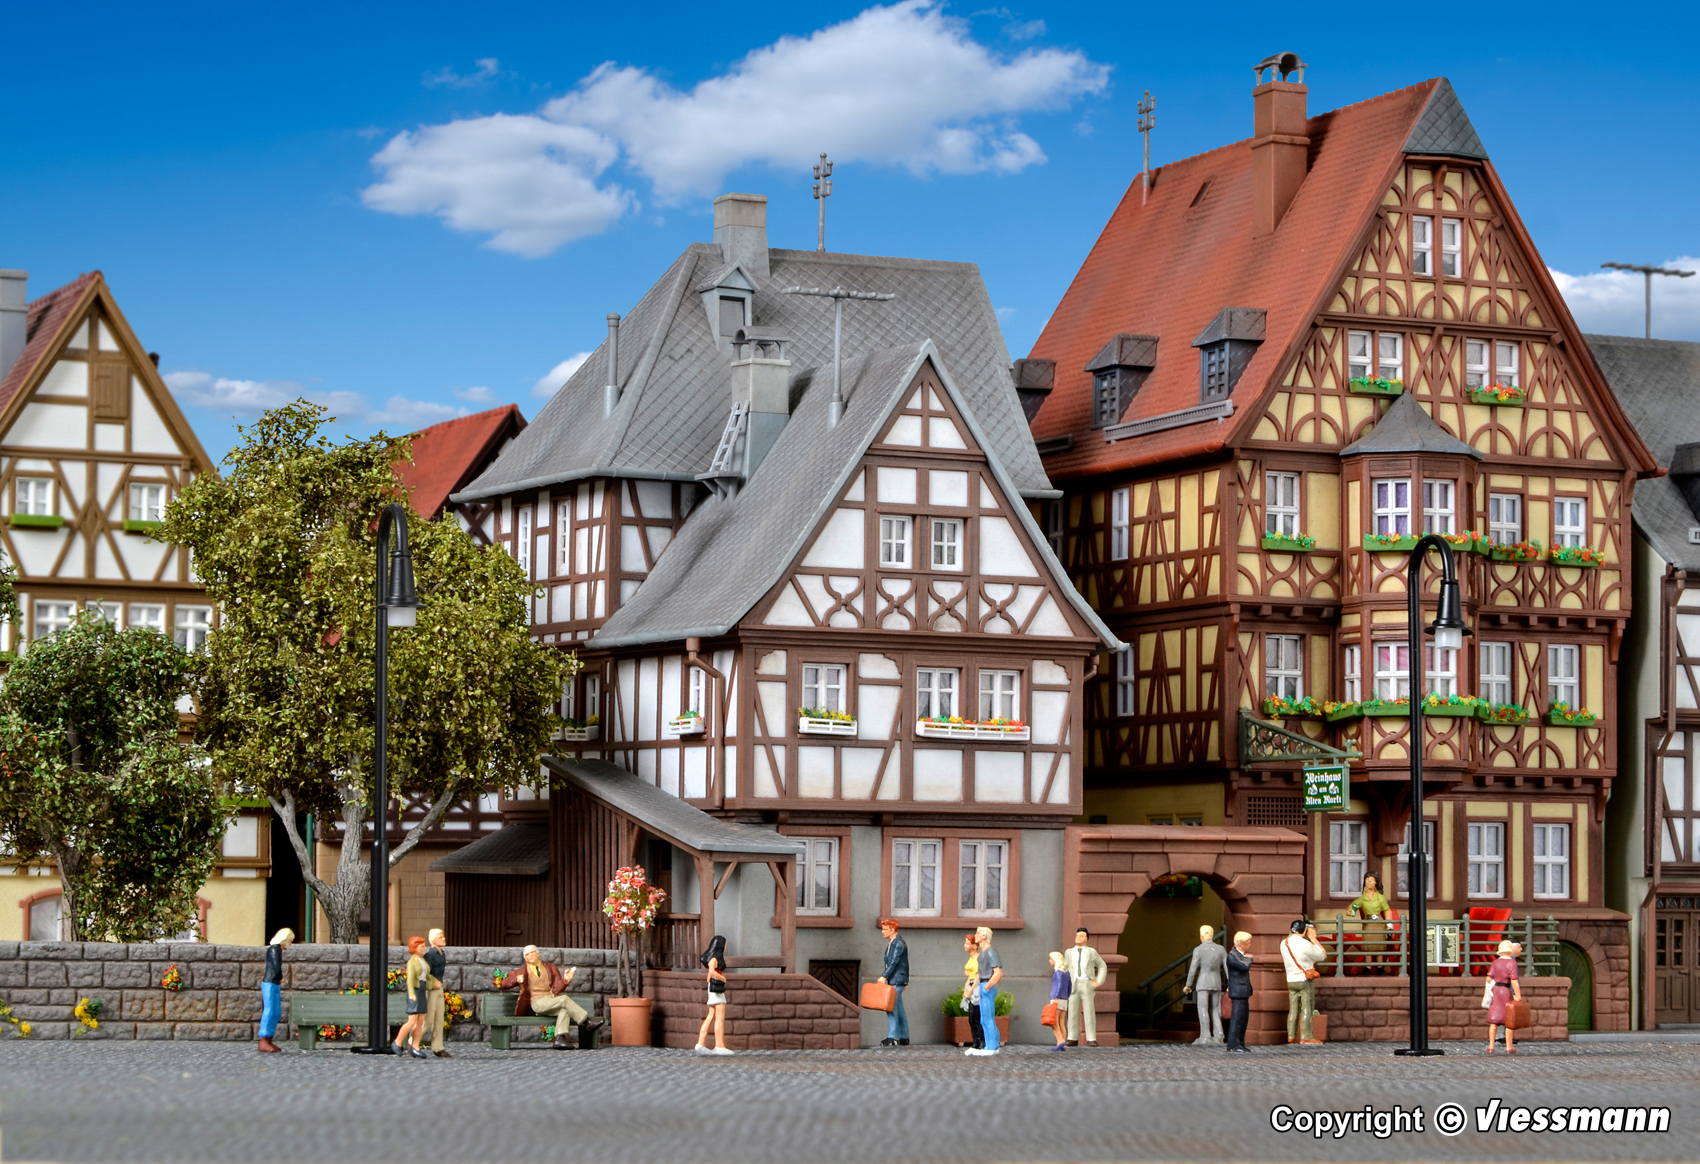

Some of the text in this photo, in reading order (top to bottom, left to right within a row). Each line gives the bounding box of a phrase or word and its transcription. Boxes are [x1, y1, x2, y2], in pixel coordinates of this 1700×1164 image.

[1305, 772, 1341, 784] Weinhaus
[1305, 795, 1341, 805] Alten Markt
